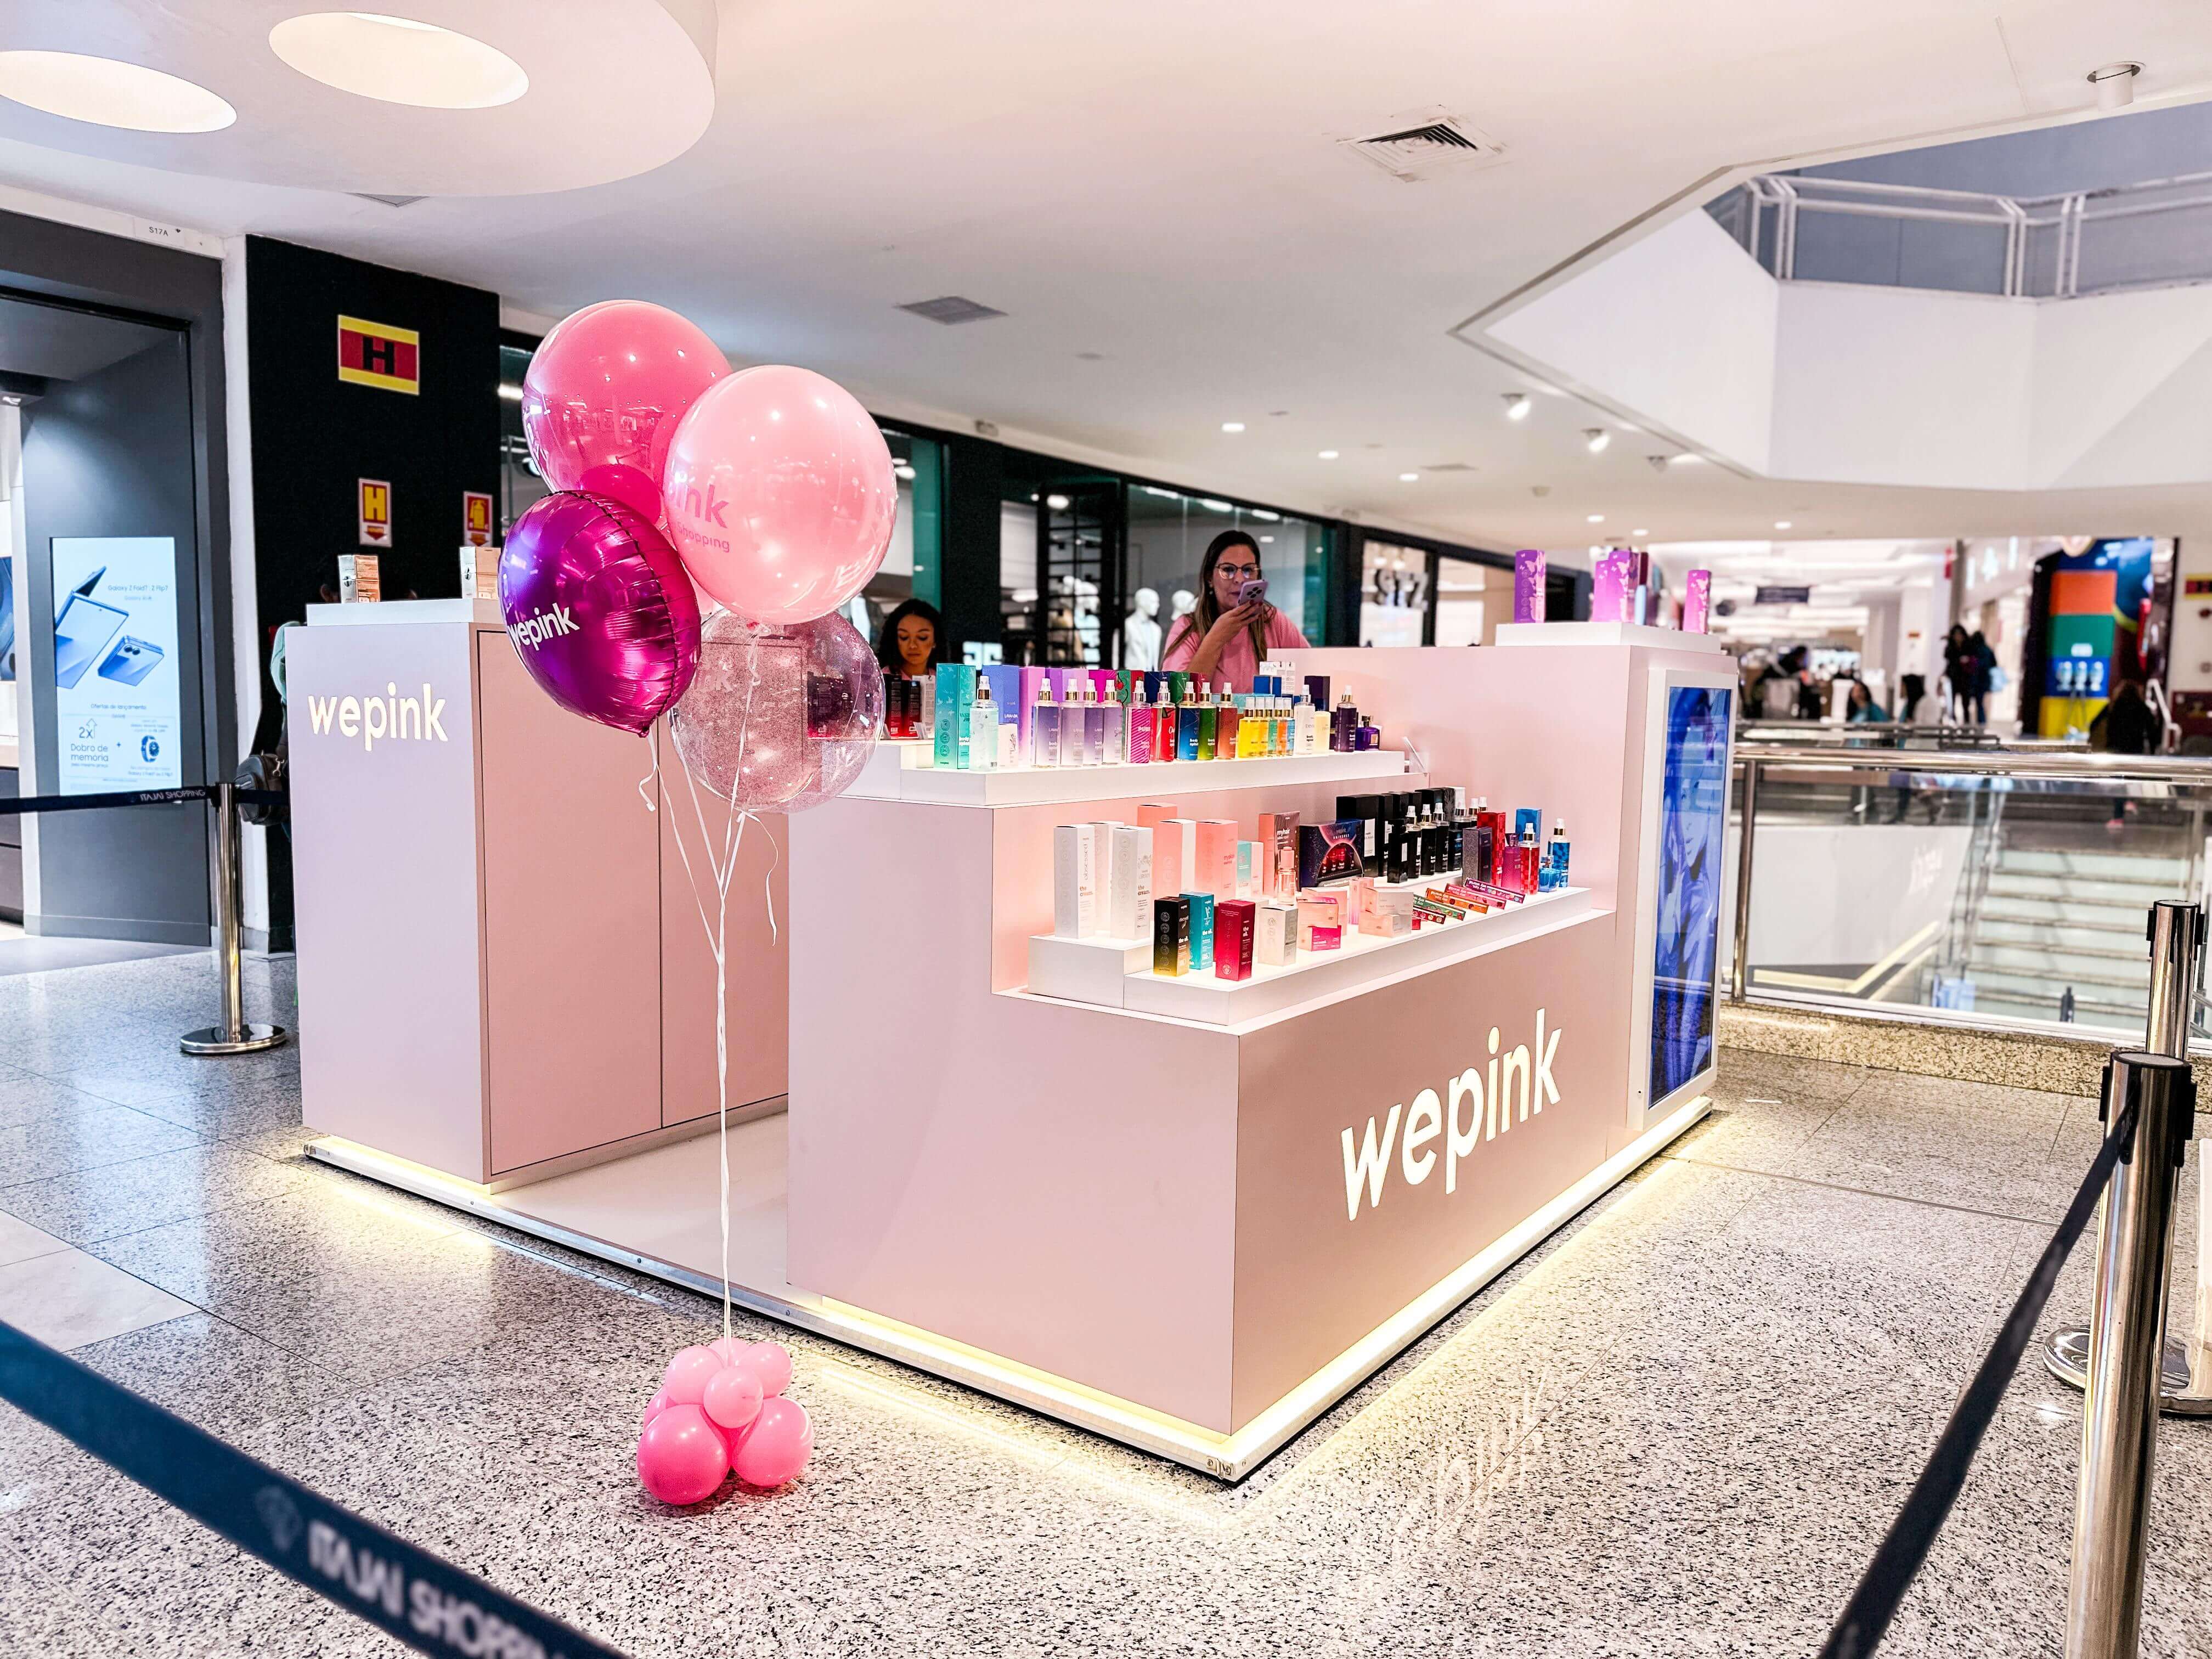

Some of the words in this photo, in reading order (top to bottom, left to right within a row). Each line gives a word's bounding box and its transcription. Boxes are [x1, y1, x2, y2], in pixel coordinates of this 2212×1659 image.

[149, 227, 168, 236] S17A
[363, 336, 394, 374] H
[364, 486, 387, 521] H
[677, 522, 730, 553] Shopping
[507, 602, 580, 651] wepink
[79, 726, 93, 739] 2x
[308, 681, 448, 752] wepink
[71, 743, 95, 752] Dobro
[165, 789, 206, 799] SHOPPING
[1341, 1007, 1562, 1222] wepink
